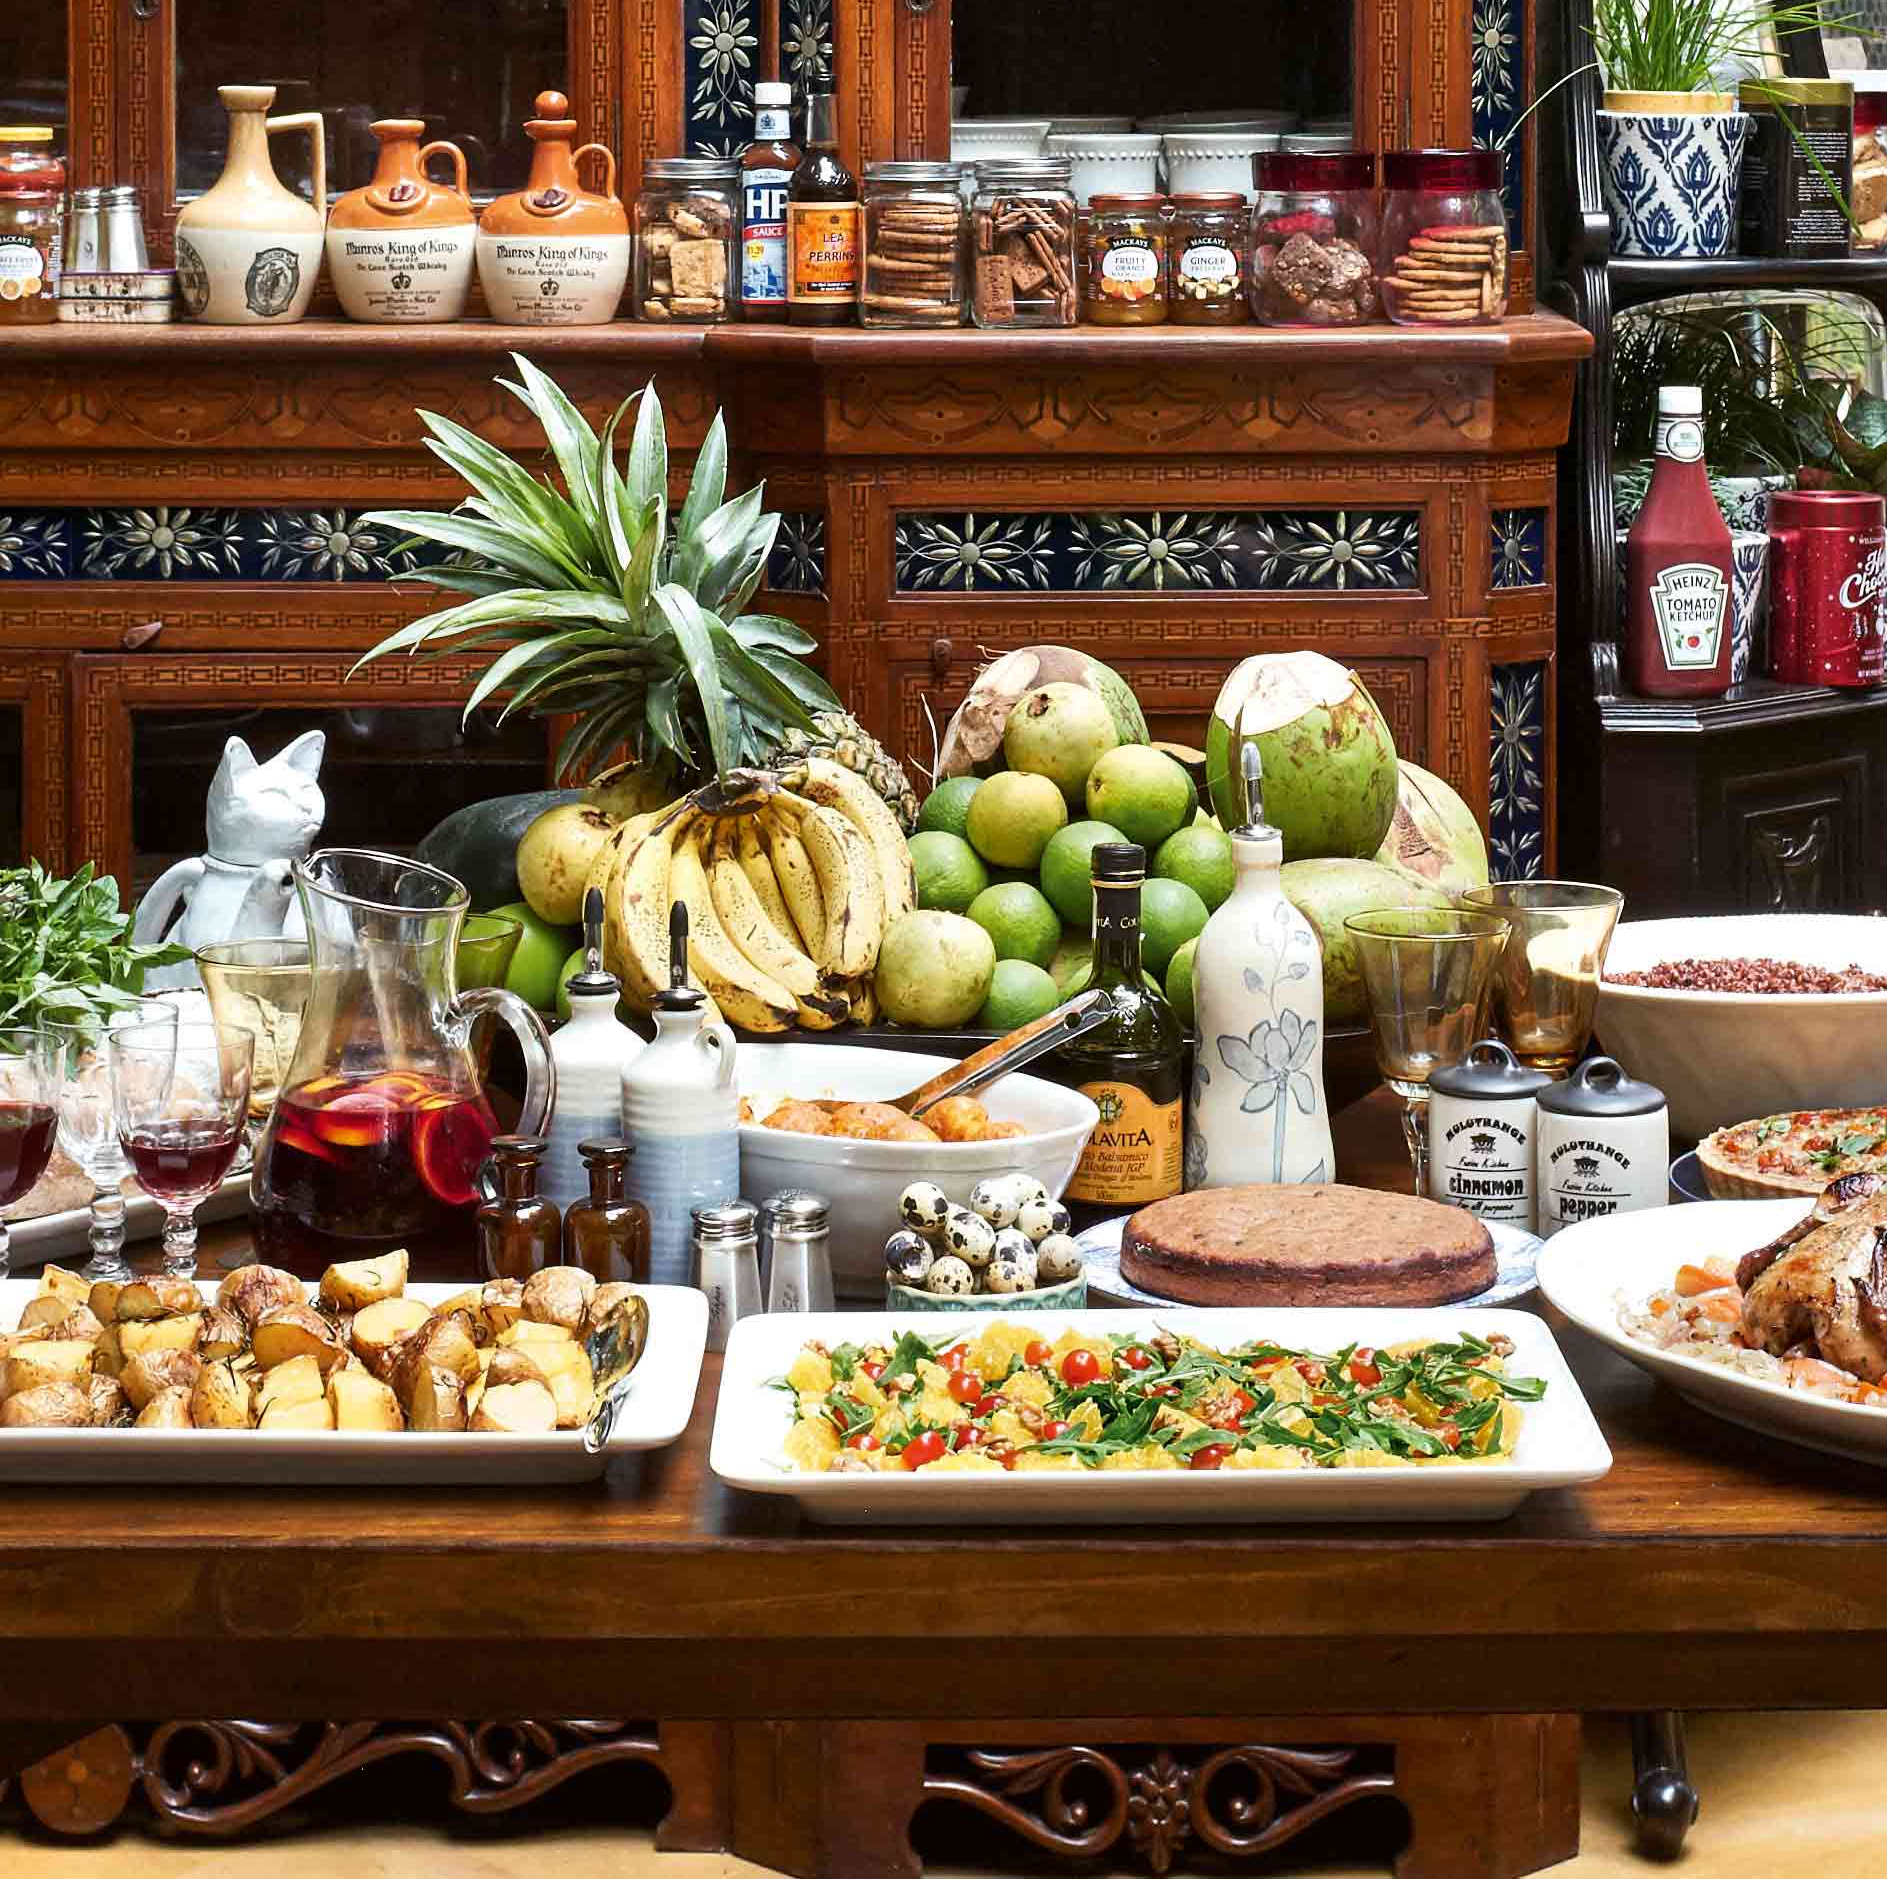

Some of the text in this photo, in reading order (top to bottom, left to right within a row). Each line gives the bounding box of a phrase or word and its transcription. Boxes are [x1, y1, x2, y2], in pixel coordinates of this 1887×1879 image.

[752, 226, 784, 237] SAUCE
[1112, 237, 1148, 248] MACKAYS
[1190, 237, 1226, 247] MACKAYS
[1190, 257, 1226, 265] GINGER
[1672, 575, 1711, 591] HEINZ
[1667, 598, 1717, 611] TOMATO
[1670, 610, 1715, 622] KETCHUP
[1087, 1128, 1152, 1147] LAVITA
[1449, 1172, 1523, 1196] cinnamon
[1560, 1196, 1617, 1221] pepper
